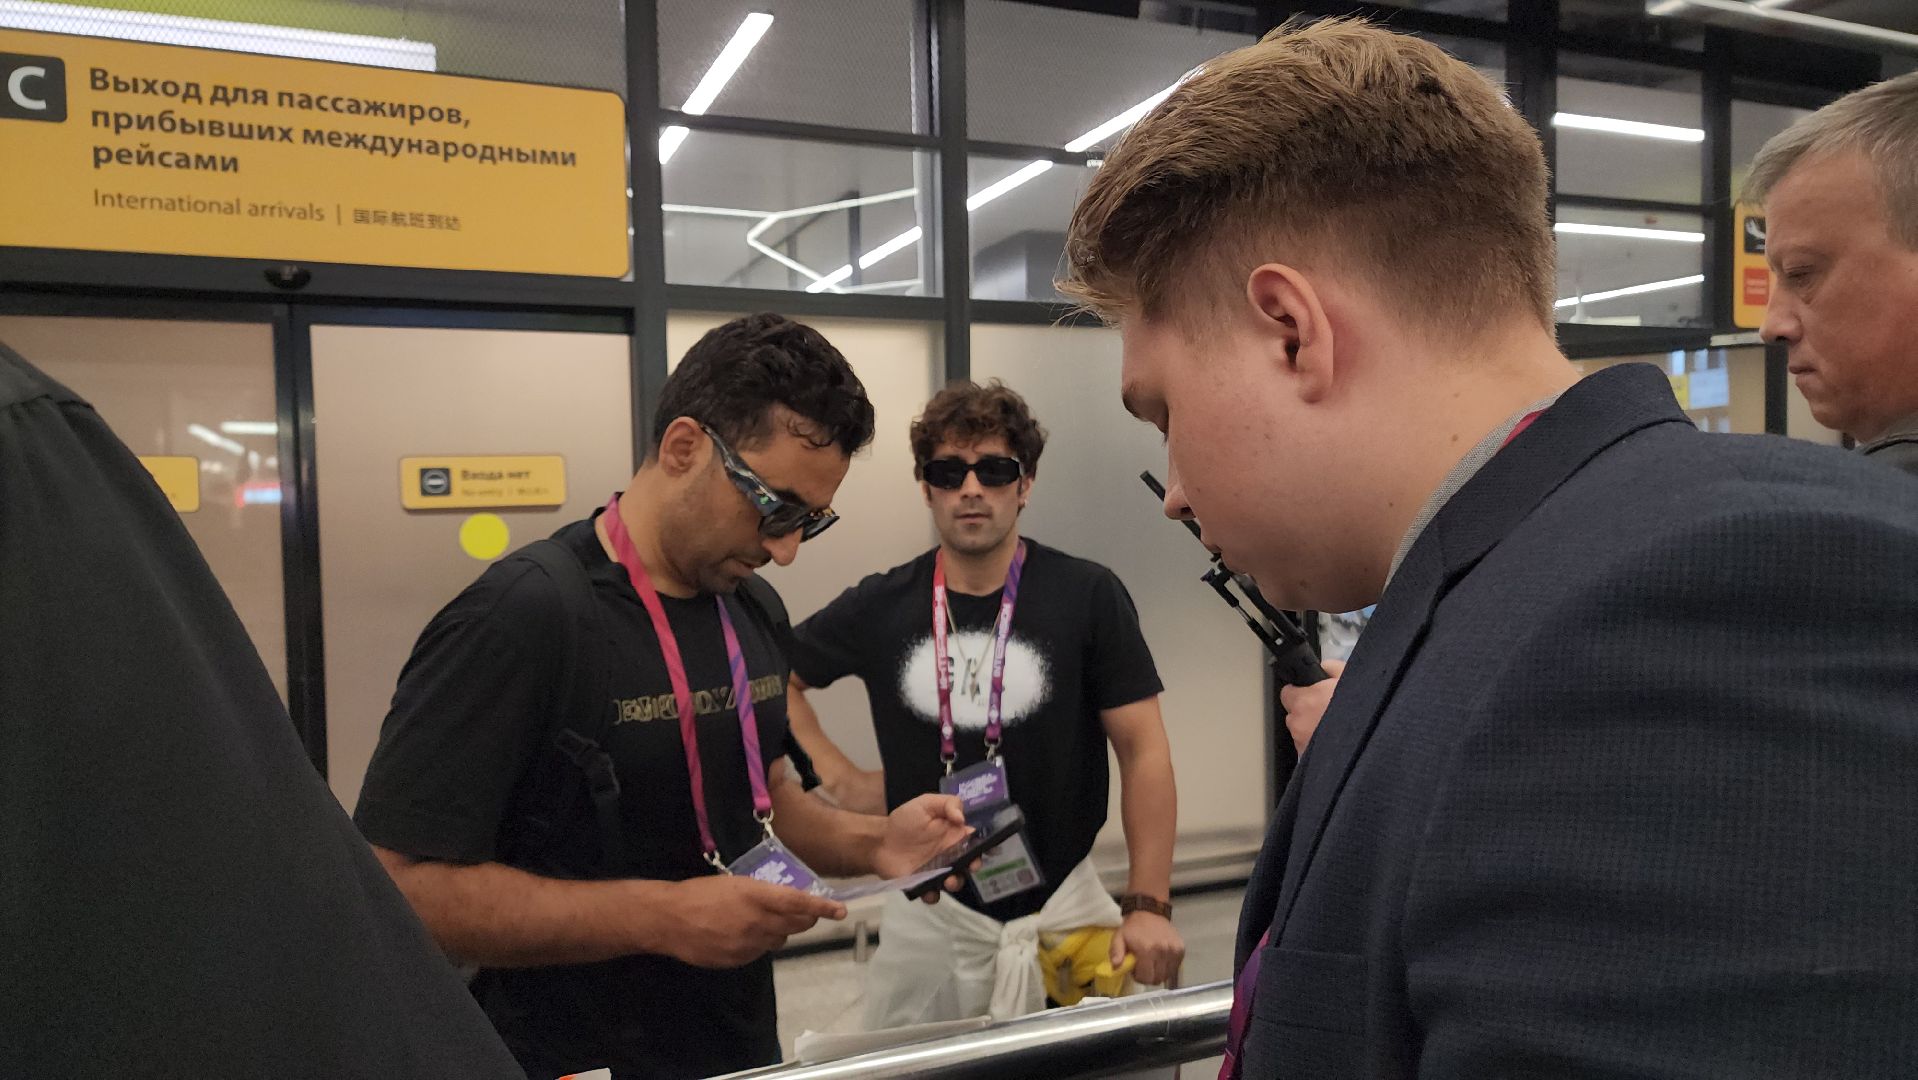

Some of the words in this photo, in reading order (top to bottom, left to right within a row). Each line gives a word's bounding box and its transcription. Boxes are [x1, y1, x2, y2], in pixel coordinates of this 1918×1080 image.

[89, 67, 202, 105] Выход
[209, 85, 268, 106] для
[277, 91, 471, 128] пассажиров,
[91, 109, 294, 145] прибывших
[302, 128, 577, 168] международными
[93, 143, 240, 174] рейсами
[93, 188, 241, 216] International
[247, 203, 325, 222] arrivals
